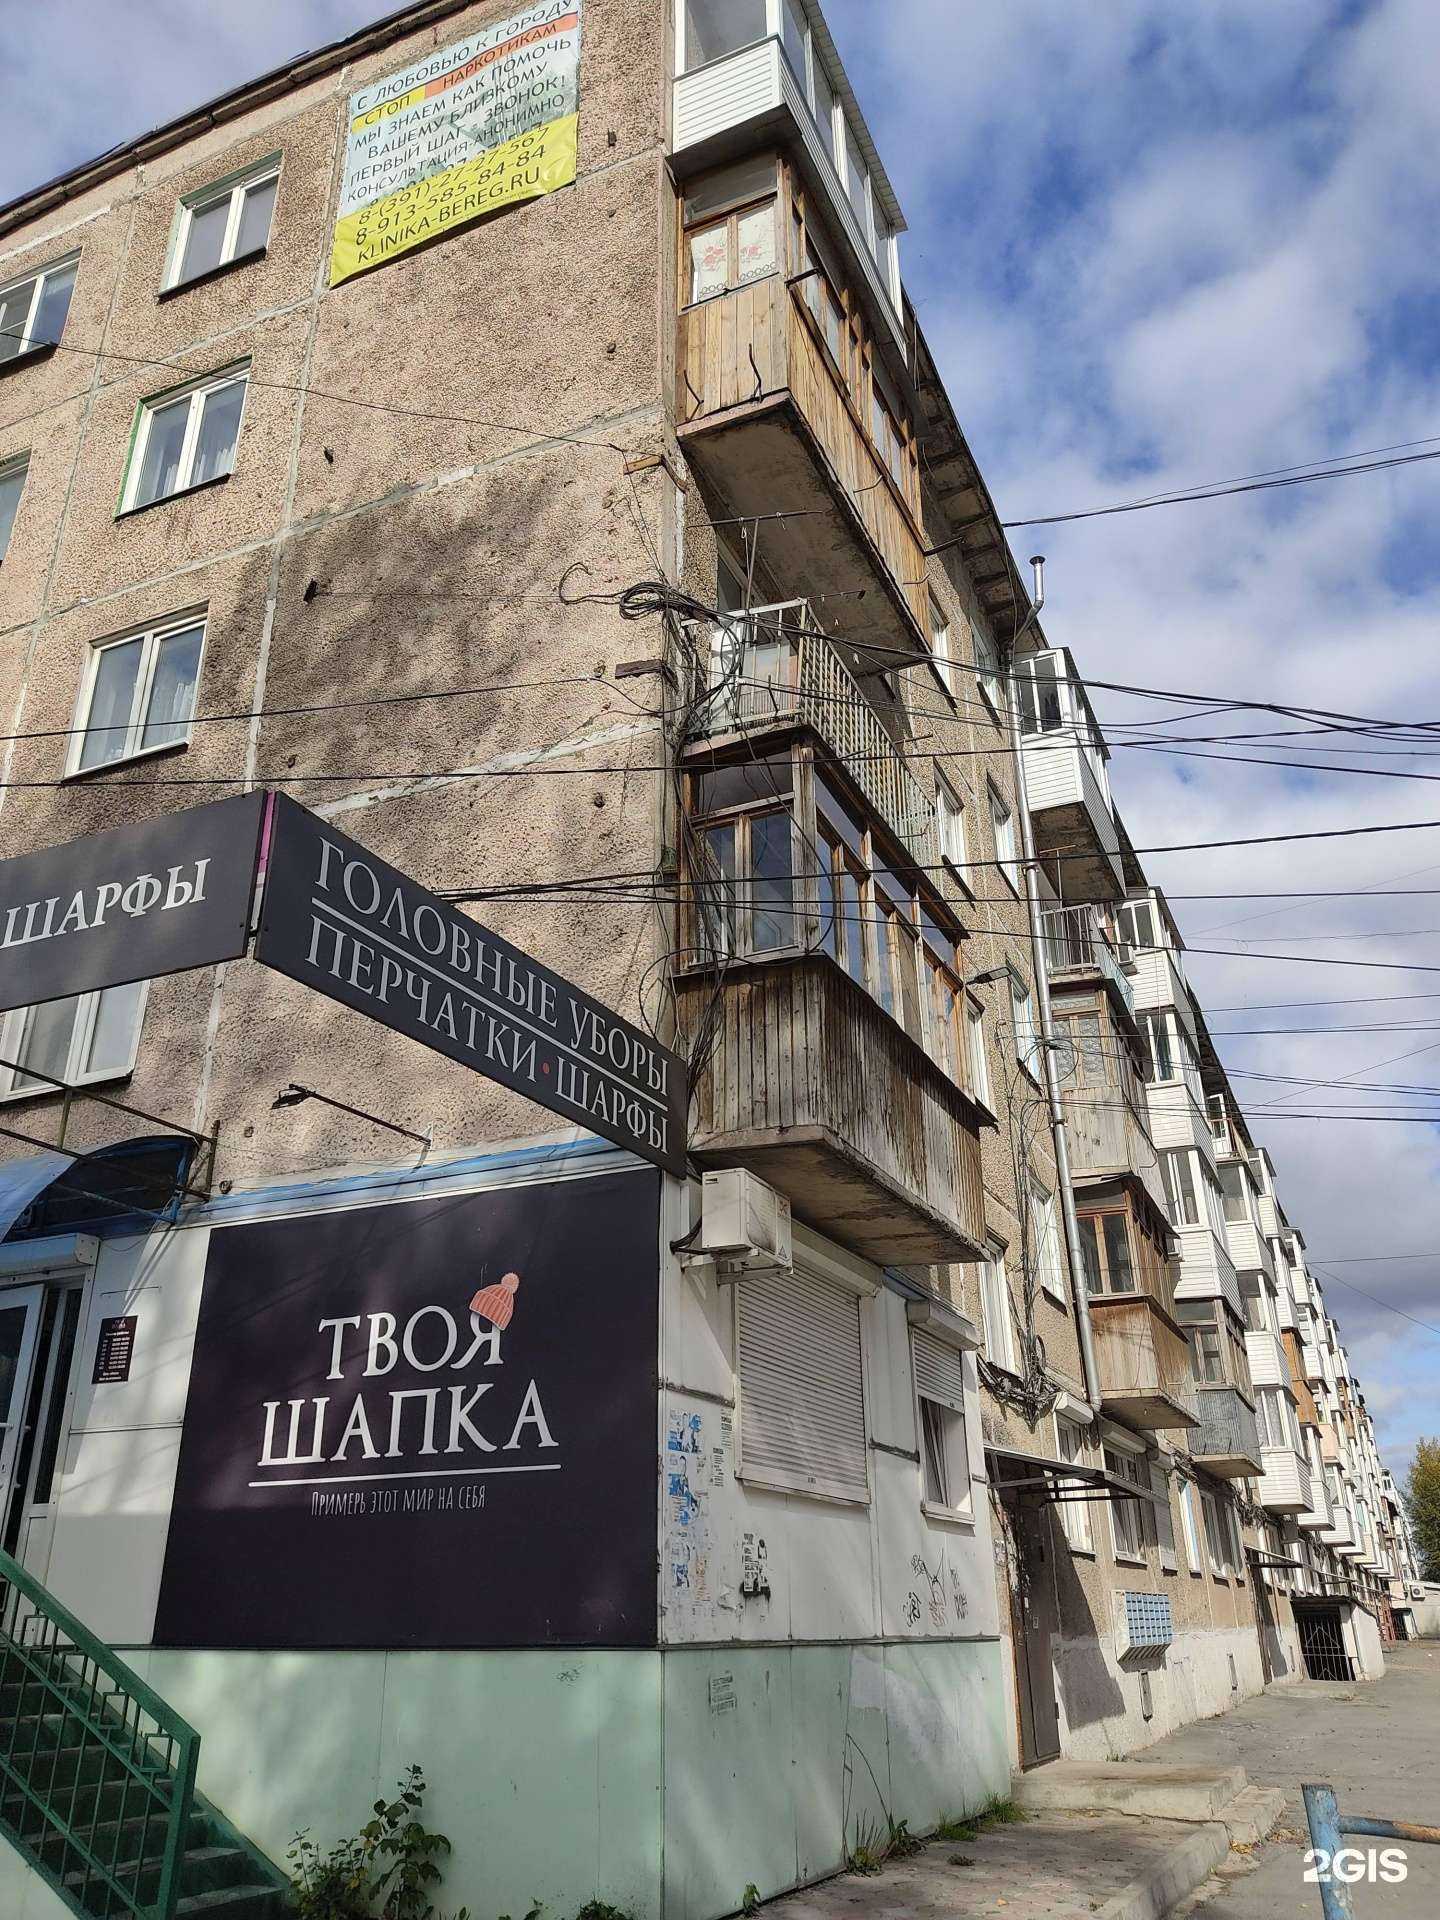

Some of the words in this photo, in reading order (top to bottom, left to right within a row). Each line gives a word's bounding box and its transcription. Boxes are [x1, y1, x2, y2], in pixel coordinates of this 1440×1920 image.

[355, 127, 381, 151] МЫ
[388, 100, 446, 134] ЗНАЕМ
[453, 77, 485, 104] КАК
[492, 39, 571, 79] ПОМОЧЬ
[358, 95, 368, 110] С
[376, 46, 470, 100] ЛЮБОВЬЮ
[476, 38, 488, 50] К
[496, 0, 572, 42] ГОРОДУ
[364, 95, 410, 125] СТОП
[443, 23, 557, 88] НАРКОТИКАМ
[350, 147, 420, 187] ПЕРВЫЙ
[428, 126, 463, 151] ШАГ
[486, 75, 566, 121] ЗВОНОК!
[368, 117, 444, 158] ВАШЕМУ
[450, 62, 549, 122] БЛИЗКОМУ
[356, 145, 545, 245] 8-913-585-84-84
[357, 167, 540, 263] KLINIKA-BEREG.RU
[0, 858, 211, 949] ШАРФЫ
[313, 836, 558, 1028] ГОЛОВНЫЕ
[567, 998, 668, 1096] УБОРЫ
[305, 914, 537, 1081] ПЕРЧАТКИ
[554, 1056, 668, 1154] ШАРФЫ
[318, 1305, 504, 1380] ТВОЯ
[257, 1379, 559, 1466] ШАПКА
[370, 1490, 399, 1513] ЭТОТ
[403, 1488, 434, 1512] МИР
[438, 1487, 453, 1510] НА
[458, 1486, 486, 1510] СЕБЯ
